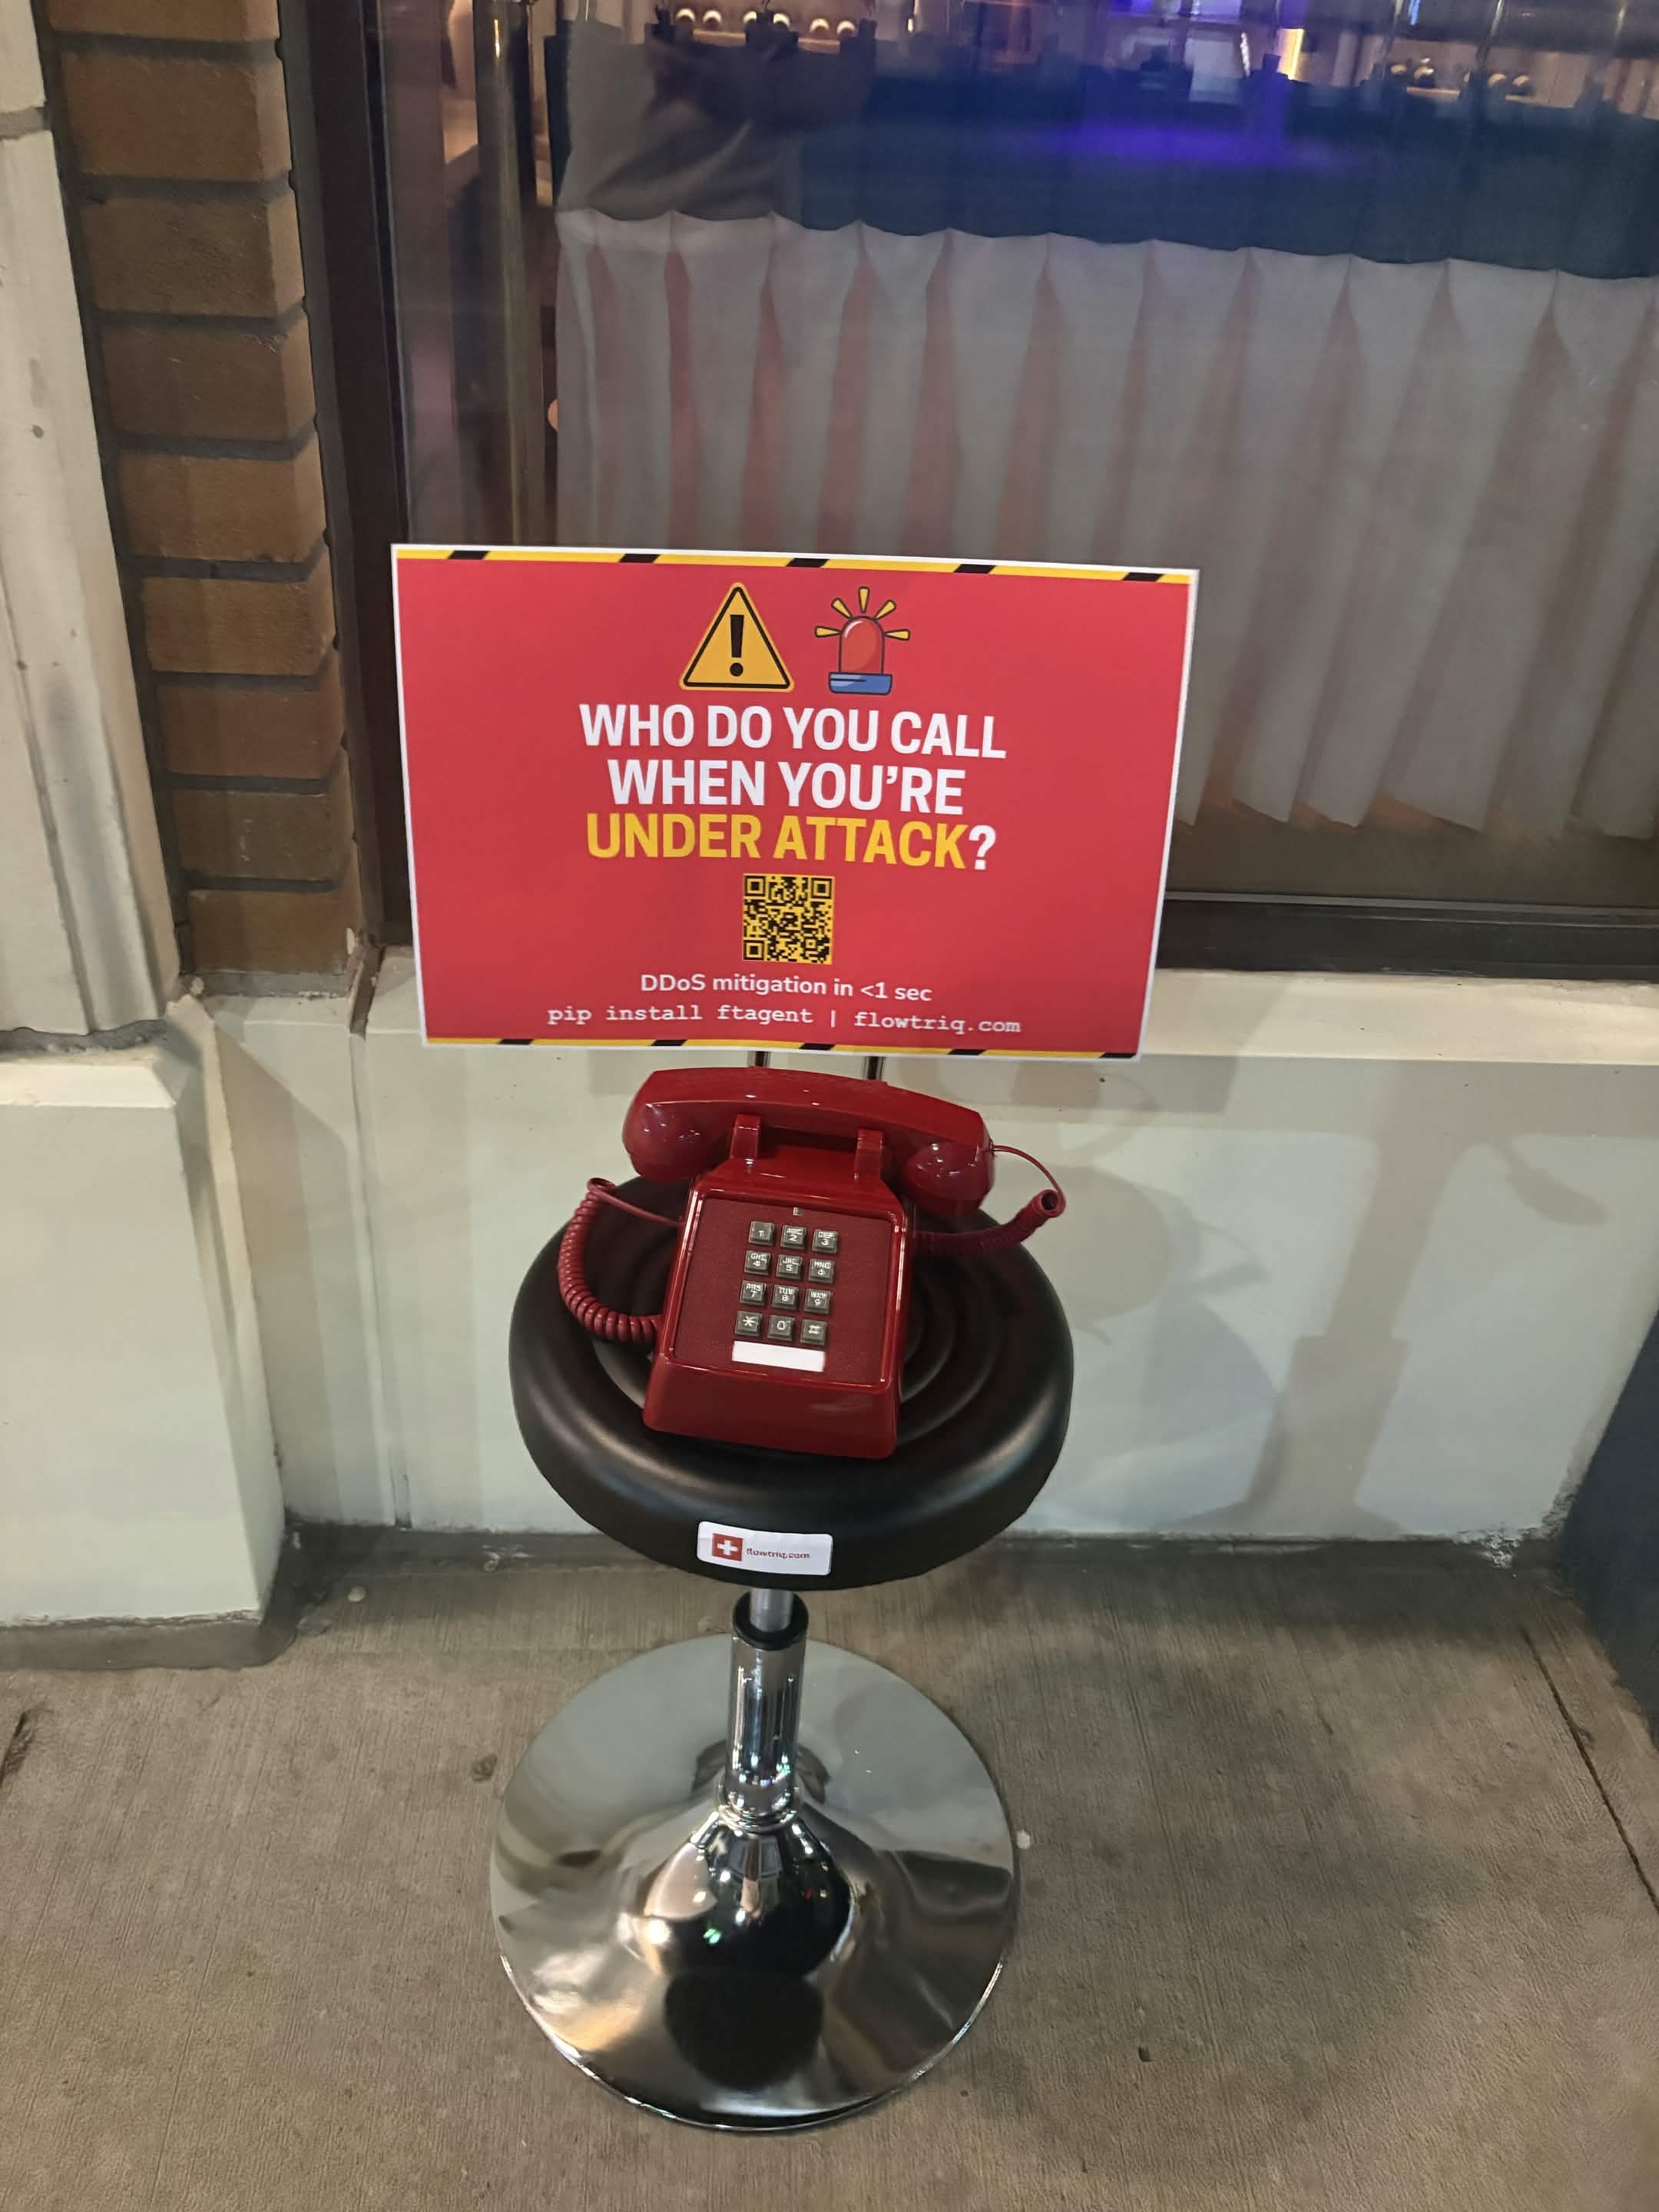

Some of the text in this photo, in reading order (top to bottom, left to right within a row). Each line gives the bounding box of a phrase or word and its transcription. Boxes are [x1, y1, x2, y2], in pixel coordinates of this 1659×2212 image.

[579, 703, 1007, 760] WHO DO YOU CALL
[607, 759, 765, 806] WHEN
[587, 813, 997, 870] UNDER ATTACK?
[641, 973, 933, 1002] DDoS mitigation in <1 sec
[547, 1005, 592, 1025] pip
[605, 1004, 704, 1022] install
[717, 1004, 814, 1025] ftagent
[853, 1011, 1022, 1035] flowtriq.com
[821, 1237, 830, 1246] 3
[750, 1290, 758, 1299] 7
[781, 1293, 790, 1302] 8
[814, 1298, 822, 1306] 9
